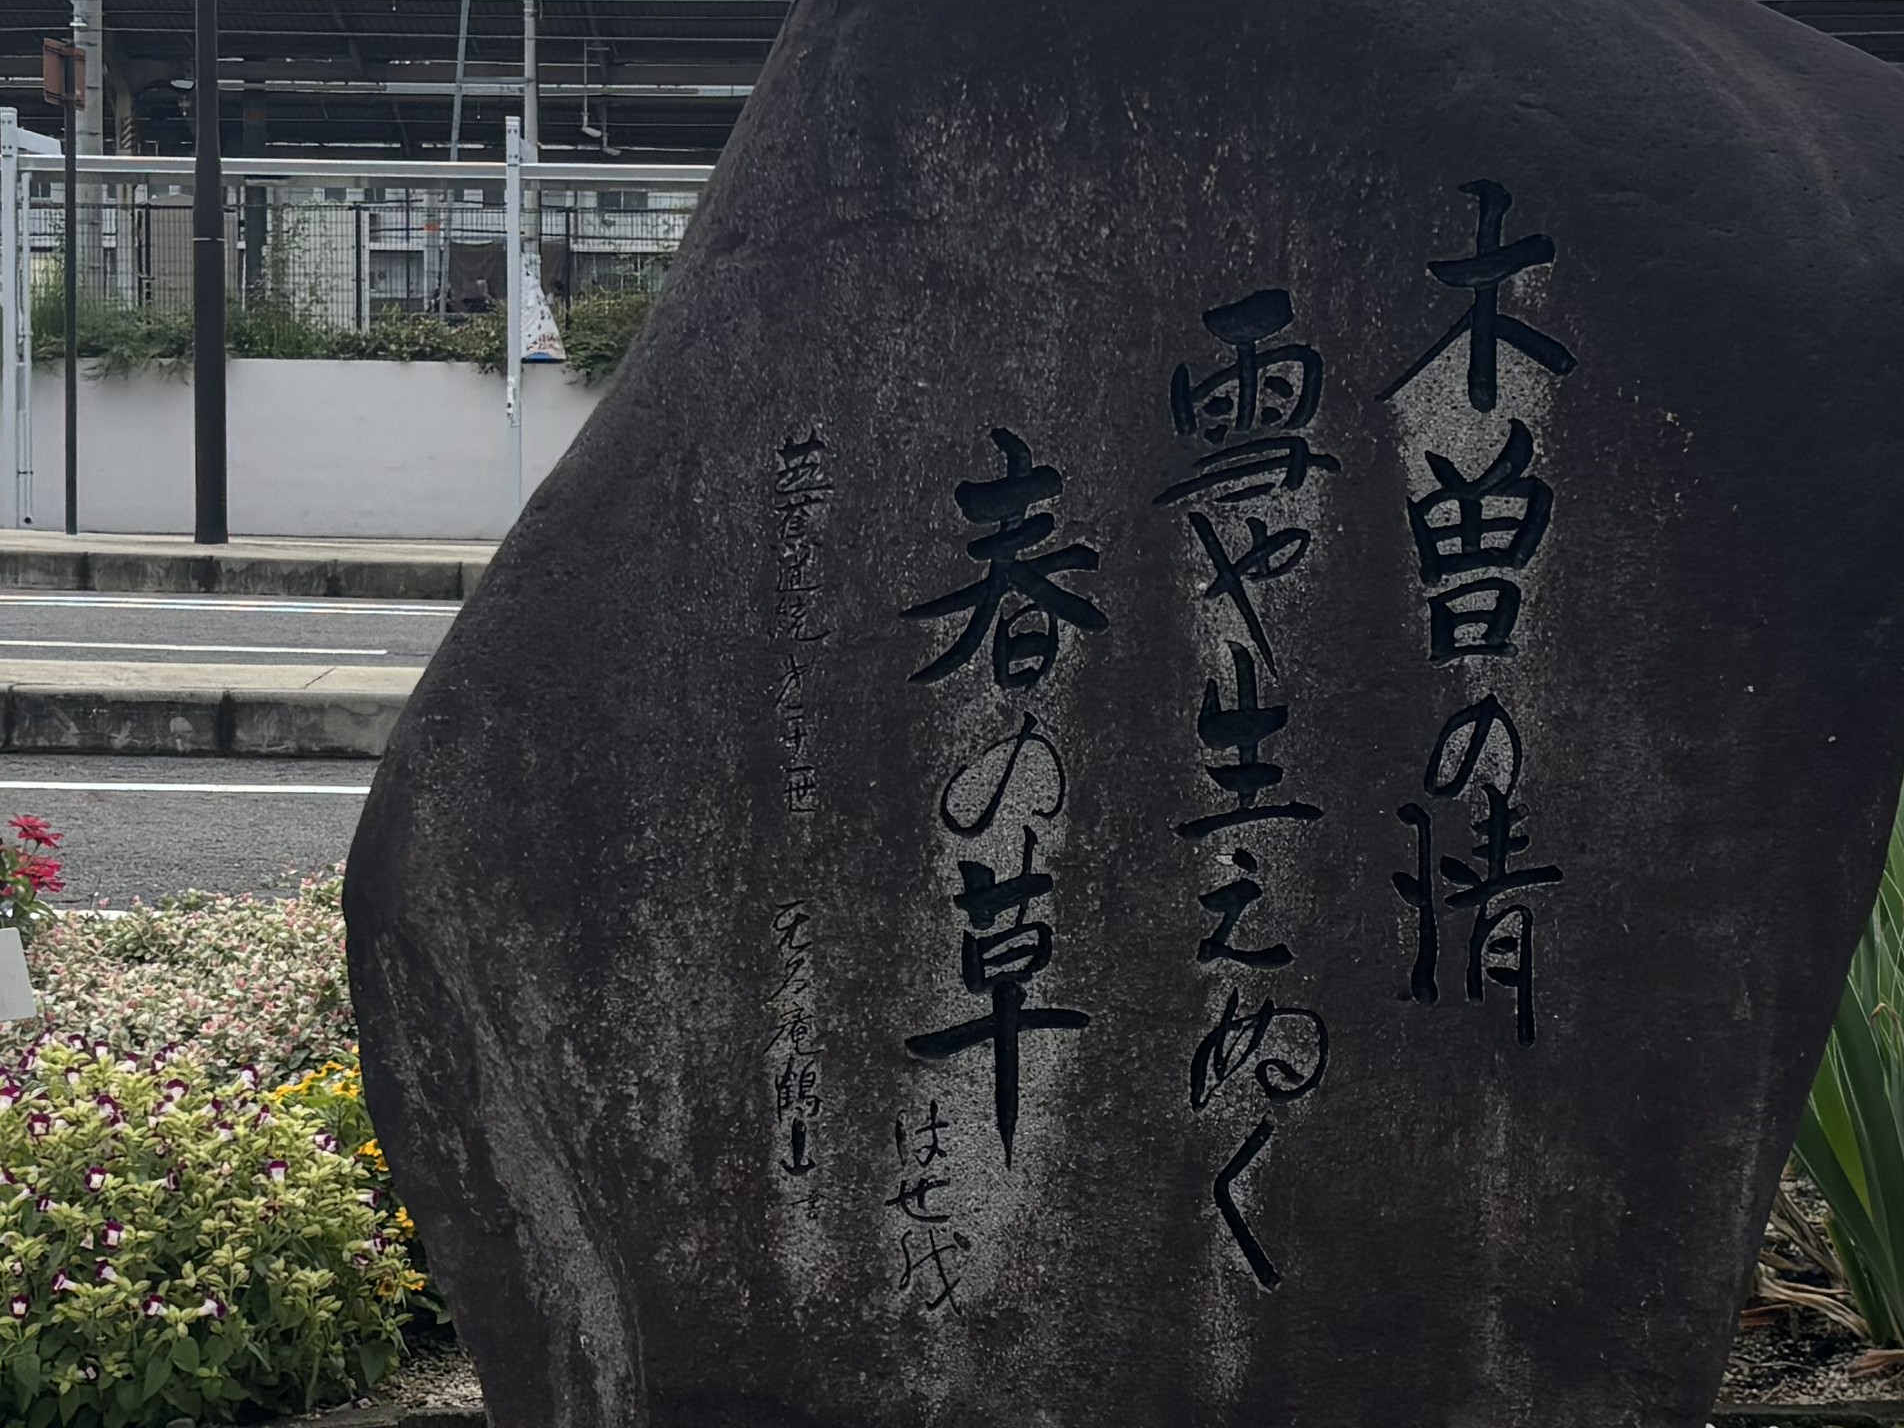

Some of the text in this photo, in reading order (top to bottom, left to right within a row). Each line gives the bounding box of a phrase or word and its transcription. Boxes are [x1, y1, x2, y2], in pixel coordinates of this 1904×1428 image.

[898, 427, 1108, 1170] 春の草
[1153, 287, 1342, 1291] 雪や生えぬく
[1375, 178, 1580, 1047] 木曽の情
